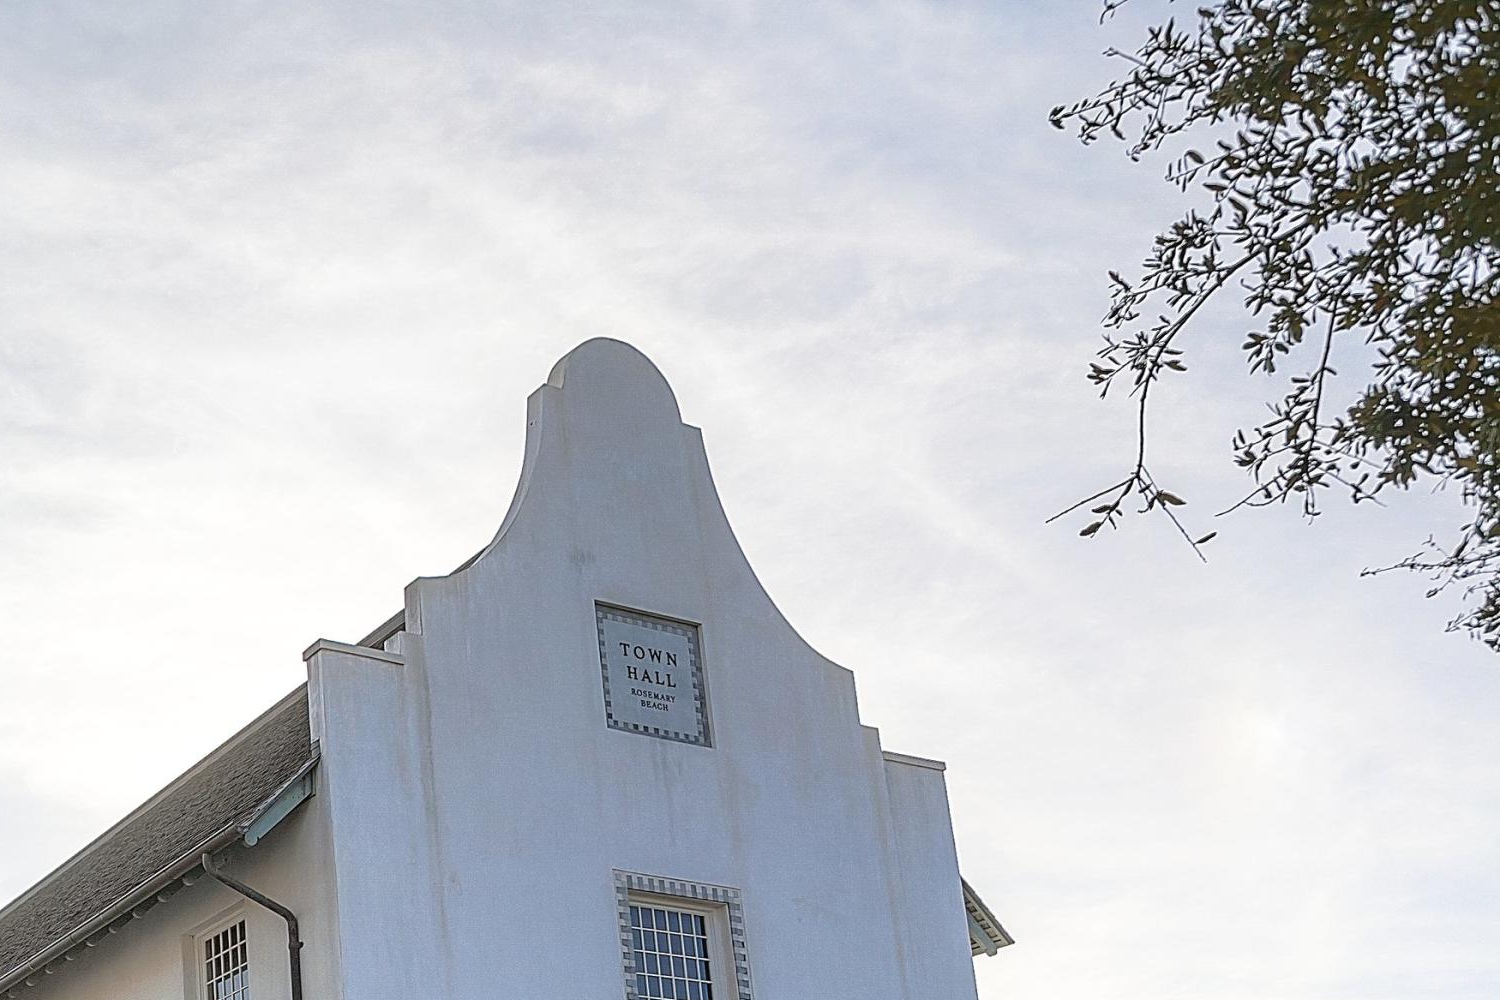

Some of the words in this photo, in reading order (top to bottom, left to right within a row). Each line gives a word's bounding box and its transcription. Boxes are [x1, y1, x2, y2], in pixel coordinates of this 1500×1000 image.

[620, 642, 677, 667] TOWN
[627, 666, 676, 687] HALL
[631, 688, 675, 702] ROSEMARY
[641, 700, 668, 711] BEACH
